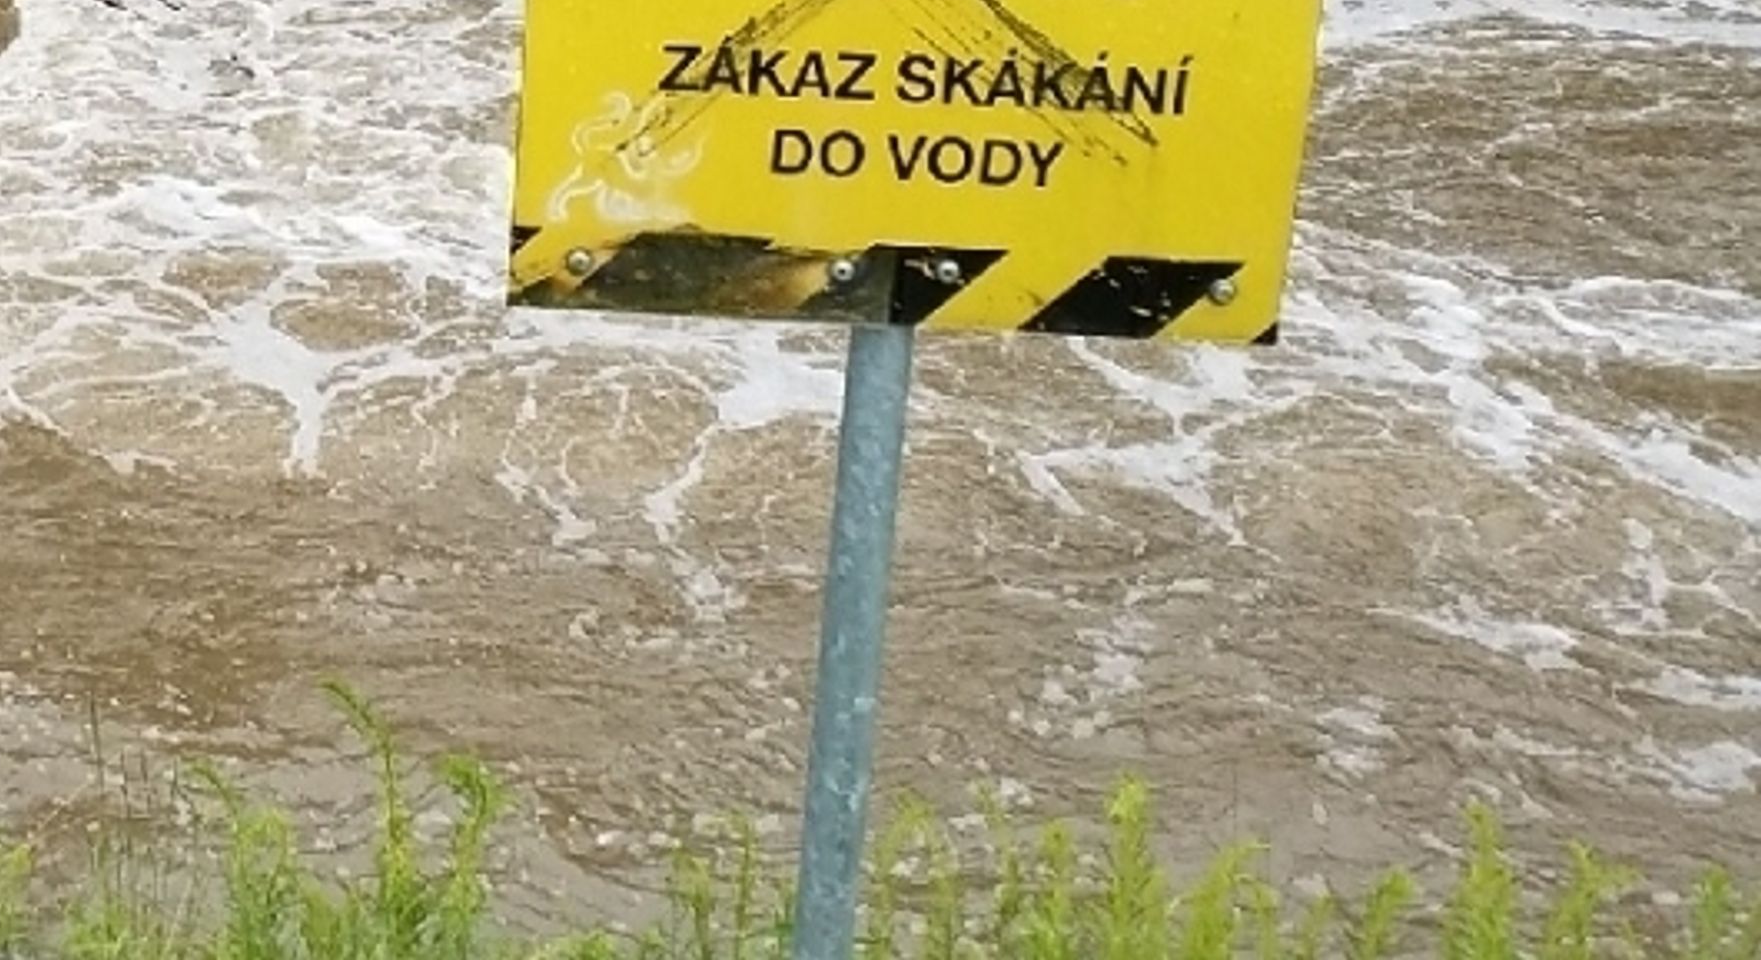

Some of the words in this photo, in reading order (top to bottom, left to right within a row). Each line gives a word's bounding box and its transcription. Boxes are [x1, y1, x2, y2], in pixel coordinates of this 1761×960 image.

[657, 35, 877, 102] ZÁKAZ
[896, 47, 1194, 117] SKÁKÁNÍ
[770, 128, 866, 176] DO
[887, 134, 1065, 188] VODY
